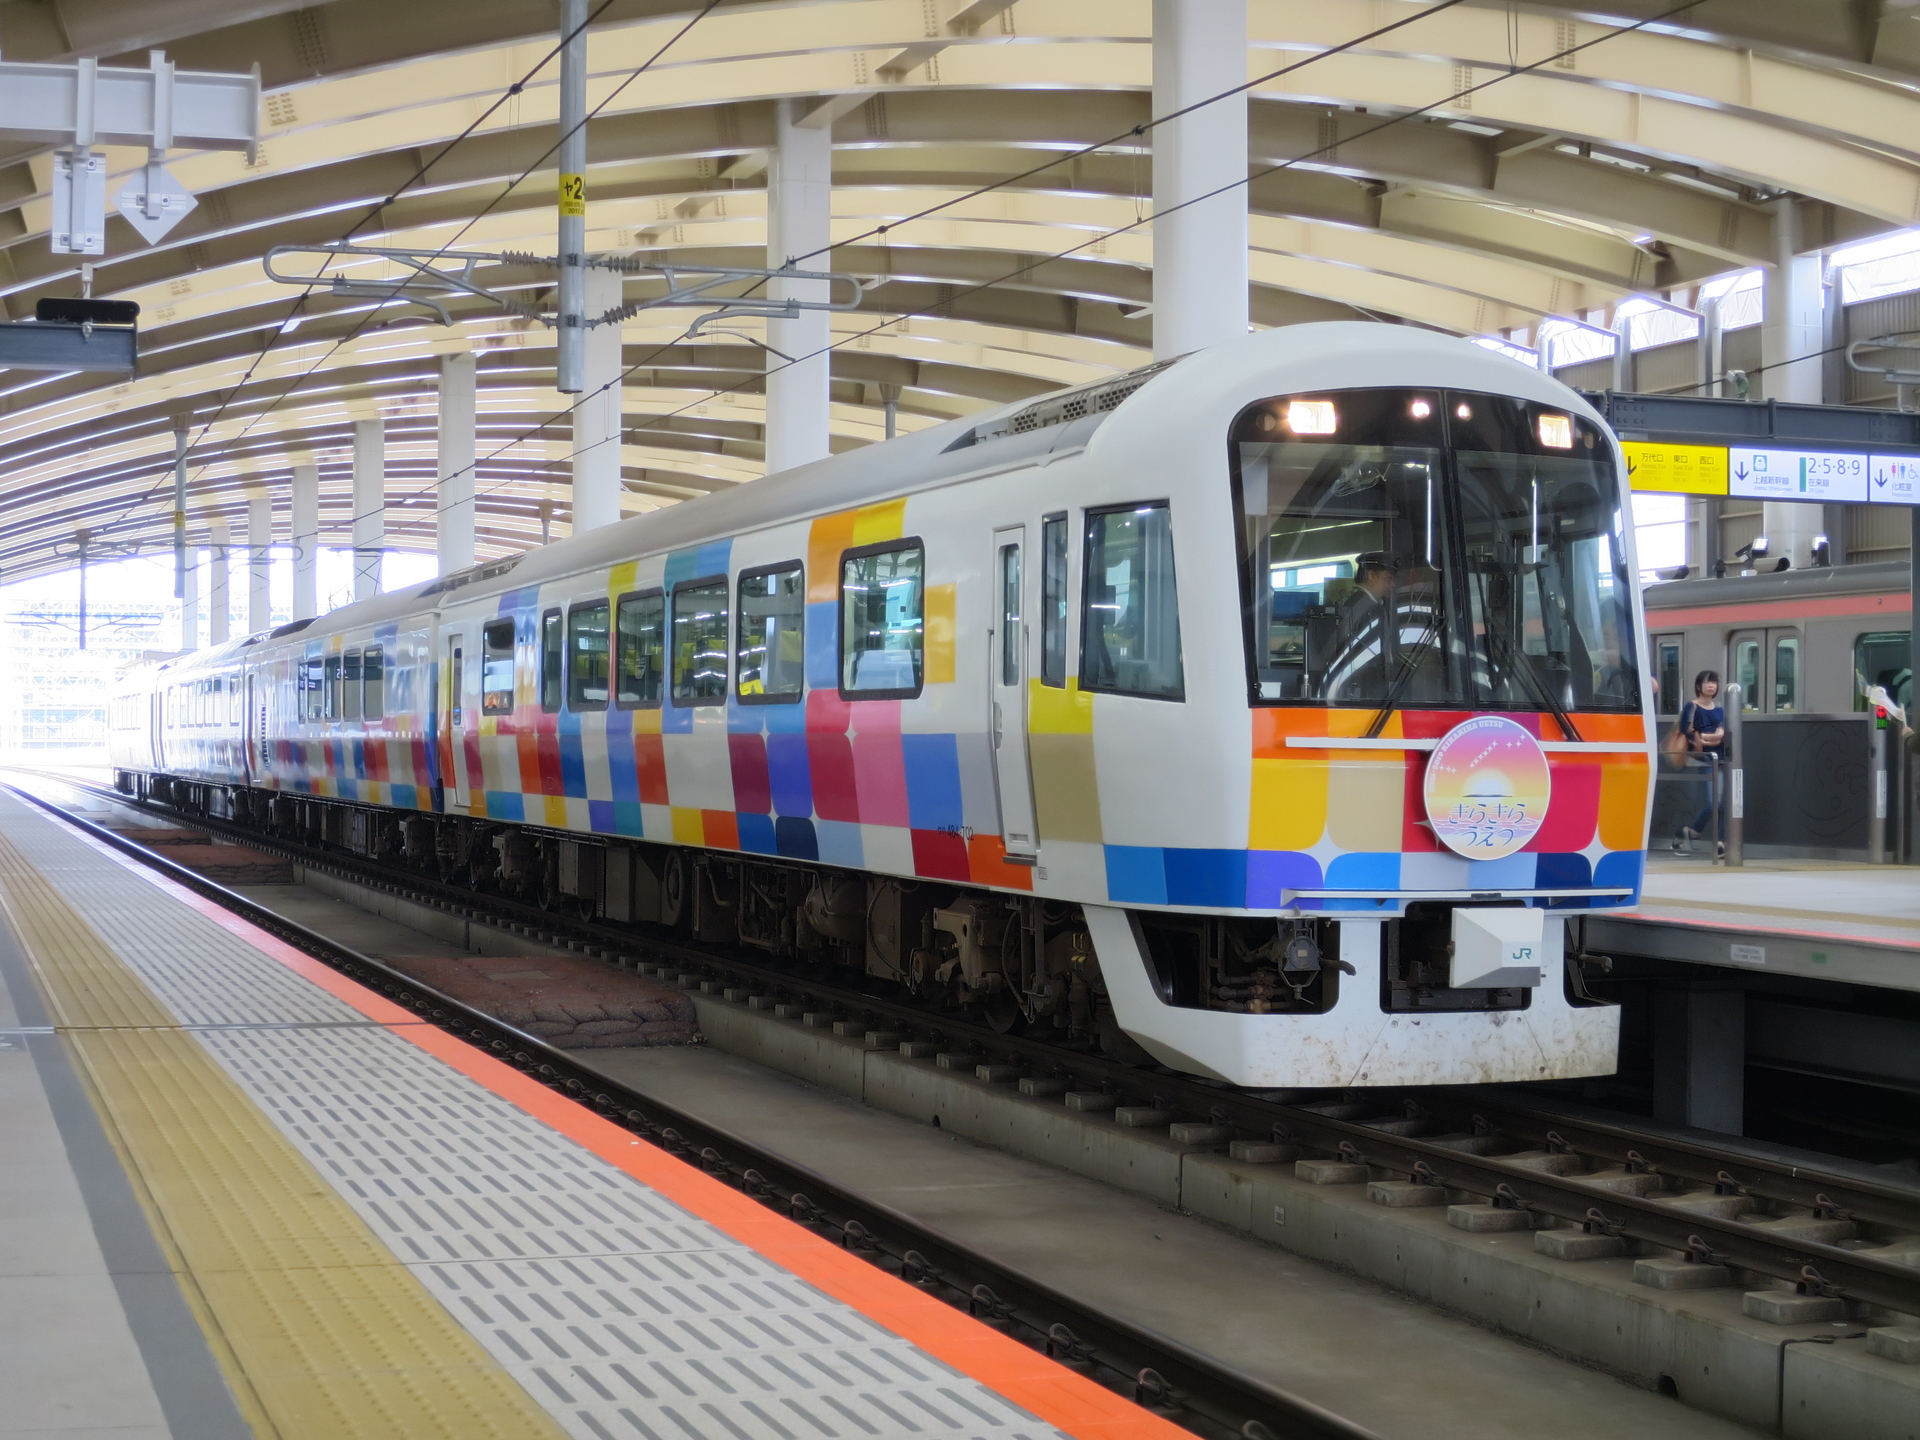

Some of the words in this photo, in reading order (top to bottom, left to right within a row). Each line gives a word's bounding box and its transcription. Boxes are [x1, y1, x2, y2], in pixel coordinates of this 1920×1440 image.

[564, 176, 585, 200] ヤ2
[1641, 453, 1664, 462] 万代口
[1673, 455, 1688, 463] 東口
[1699, 456, 1715, 465] 西口
[1753, 475, 1789, 485] 上越新幹線
[1808, 478, 1830, 487] 在来線
[1891, 482, 1912, 491] 化粧室
[1441, 722, 1478, 753] KIRAKIRA
[1478, 720, 1504, 728] UETSU
[1449, 803, 1526, 824] きらきら
[1461, 826, 1514, 847] うえつ
[1512, 947, 1532, 960] JR
